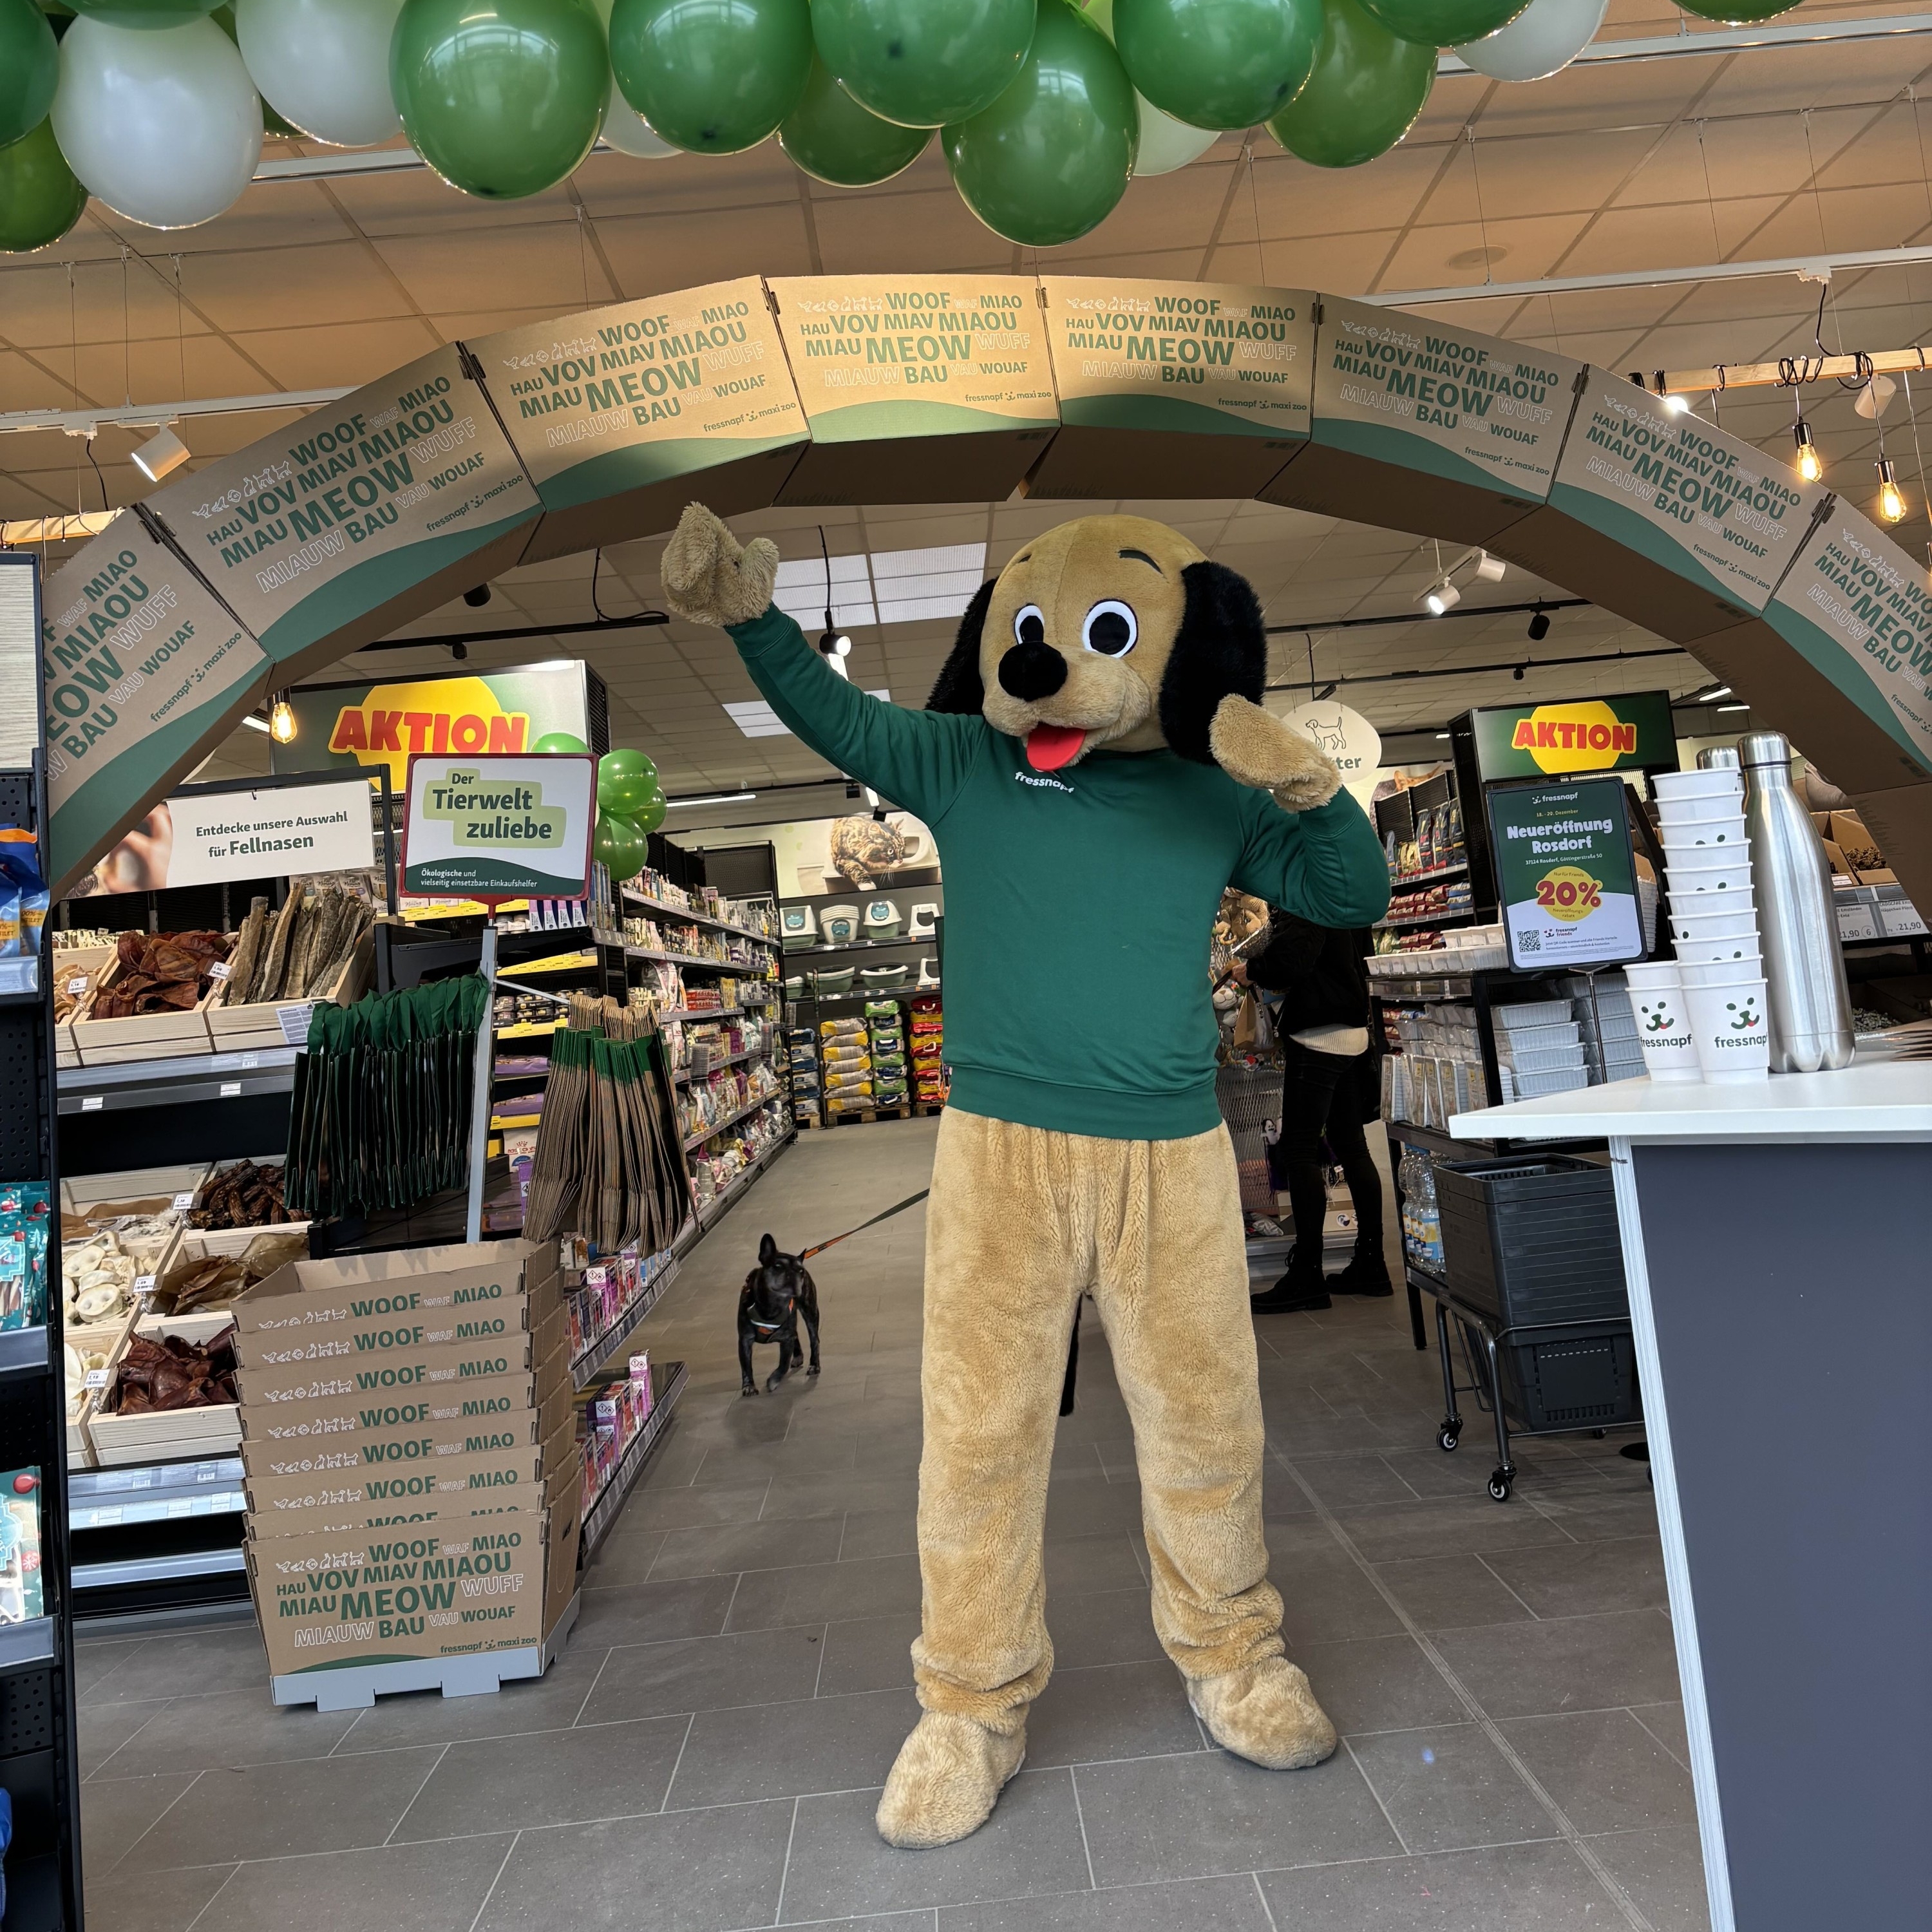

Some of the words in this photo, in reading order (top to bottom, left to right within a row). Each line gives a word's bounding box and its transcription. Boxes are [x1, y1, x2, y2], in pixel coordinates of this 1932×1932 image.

[800, 323, 829, 334] HAU
[829, 314, 878, 334] VOV
[884, 313, 933, 330] MIAV
[938, 310, 1017, 331] MIAOU
[1066, 317, 1094, 329] HAU
[1095, 312, 1144, 332] VOV
[1149, 316, 1199, 333] MIAV
[1204, 319, 1285, 341] MIAOU
[510, 377, 544, 395] HAU
[540, 355, 596, 385] VOV
[600, 342, 654, 370] MIAV
[659, 320, 747, 359] MIAOU
[1068, 332, 1122, 350] MIAU
[1126, 336, 1235, 365] MEOW
[1239, 342, 1296, 361] WUFF
[520, 386, 582, 418] MIAU
[585, 357, 701, 412] MEOW
[703, 341, 764, 371] WUFF
[1336, 339, 1363, 354] HAU
[1366, 339, 1412, 366] VOV
[1414, 354, 1464, 379] MIAV
[1466, 368, 1546, 404] MIAOU
[965, 393, 1003, 402] fressnapf
[1016, 391, 1036, 399] maxi
[1218, 399, 1256, 408] fressnapf
[1333, 354, 1387, 380] MIAU
[1386, 368, 1493, 417] MEOW
[1497, 397, 1553, 424] WUFF
[288, 413, 366, 467] WOOF
[370, 406, 399, 428] WAF
[398, 376, 450, 413] MIAO
[704, 414, 744, 432] fressnapf
[758, 405, 779, 417] maxi
[780, 403, 795, 412] zoo
[207, 519, 243, 545] HAU
[235, 480, 297, 524] VOV
[297, 448, 357, 493] MIAV
[358, 399, 454, 464] MIAOU
[1465, 446, 1502, 462] fressnapf
[1515, 462, 1535, 471] maxi
[1593, 411, 1620, 431] HAU
[1622, 418, 1666, 453] VOV
[1663, 444, 1713, 477] MIAV
[1710, 469, 1786, 520] MIAOU
[220, 518, 288, 568] MIAU
[288, 451, 414, 543] MEOW
[409, 416, 476, 462] WUFF
[1586, 425, 1638, 461] MIAU
[1631, 453, 1734, 519] MEOW
[1735, 503, 1787, 540] WUFF
[427, 502, 469, 532] fressnapf
[484, 482, 507, 500] maxi
[506, 475, 523, 488] zoo
[1694, 544, 1728, 566] fressnapf
[1739, 569, 1758, 582] maxi
[1757, 580, 1770, 589] zoo
[1815, 555, 1862, 598] MIAU
[57, 598, 88, 627] WAF
[82, 550, 137, 602] MIAO
[1826, 542, 1850, 565] HAU
[1850, 556, 1891, 597] VOV
[1886, 592, 1932, 632] MIAV
[52, 574, 149, 670] MIAOU
[151, 679, 193, 722] fressnapf
[204, 646, 227, 670] maxi
[225, 633, 242, 649] zoo
[1891, 694, 1923, 723] fressnapf
[333, 710, 525, 752] AKTION
[1515, 722, 1634, 751] AKTION
[451, 773, 474, 784] Der
[1015, 772, 1074, 793] fressnapf
[433, 788, 533, 810] Tierwelt
[1542, 792, 1578, 802] fressnapf
[196, 822, 251, 837] Entdecke
[253, 819, 294, 831] unsere
[296, 811, 348, 827] Auswahl
[466, 816, 552, 839] zuliebe
[1507, 819, 1613, 839] Neueröffnung
[209, 846, 227, 858] für
[229, 836, 314, 855] Fellnasen
[1532, 835, 1592, 853] Rosdorf
[421, 867, 462, 878] Ökologische
[464, 869, 476, 877] und
[421, 878, 450, 888] vielseitig
[490, 879, 538, 888] Einkaufshelfer
[1898, 922, 1921, 931] 21,90
[1714, 1032, 1768, 1048] fressnap
[350, 1293, 420, 1317] WOOF
[424, 1296, 450, 1305] WAF
[453, 1285, 502, 1304] MIAO
[354, 1327, 423, 1350] WOOF
[427, 1331, 453, 1341] WAF
[457, 1319, 505, 1338] MIAO
[359, 1403, 430, 1427] WOOF
[433, 1408, 459, 1419] WAF
[463, 1397, 510, 1416] MIAO
[363, 1439, 432, 1463] WOOF
[436, 1443, 461, 1455] WAF
[466, 1433, 514, 1451] MIAO
[366, 1475, 436, 1500] WOOF
[439, 1481, 465, 1491] WAF
[469, 1470, 517, 1488] MIAO
[368, 1539, 439, 1562] WOOF
[442, 1543, 469, 1554] WAF
[473, 1533, 521, 1551] MIAO
[277, 1582, 305, 1595] HAU
[307, 1569, 359, 1591] VOV
[364, 1562, 417, 1584] MIAV
[423, 1551, 511, 1580] MIAOU
[280, 1595, 336, 1617] MIAU
[341, 1582, 456, 1620] MEOW
[460, 1574, 523, 1596] WUFF
[295, 1622, 374, 1647] MIAUW
[379, 1616, 424, 1638] BAU
[429, 1612, 458, 1626] VAU
[461, 1606, 515, 1622] WOUAF
[440, 1642, 482, 1653] fressnapf
[498, 1637, 519, 1647] maxi
